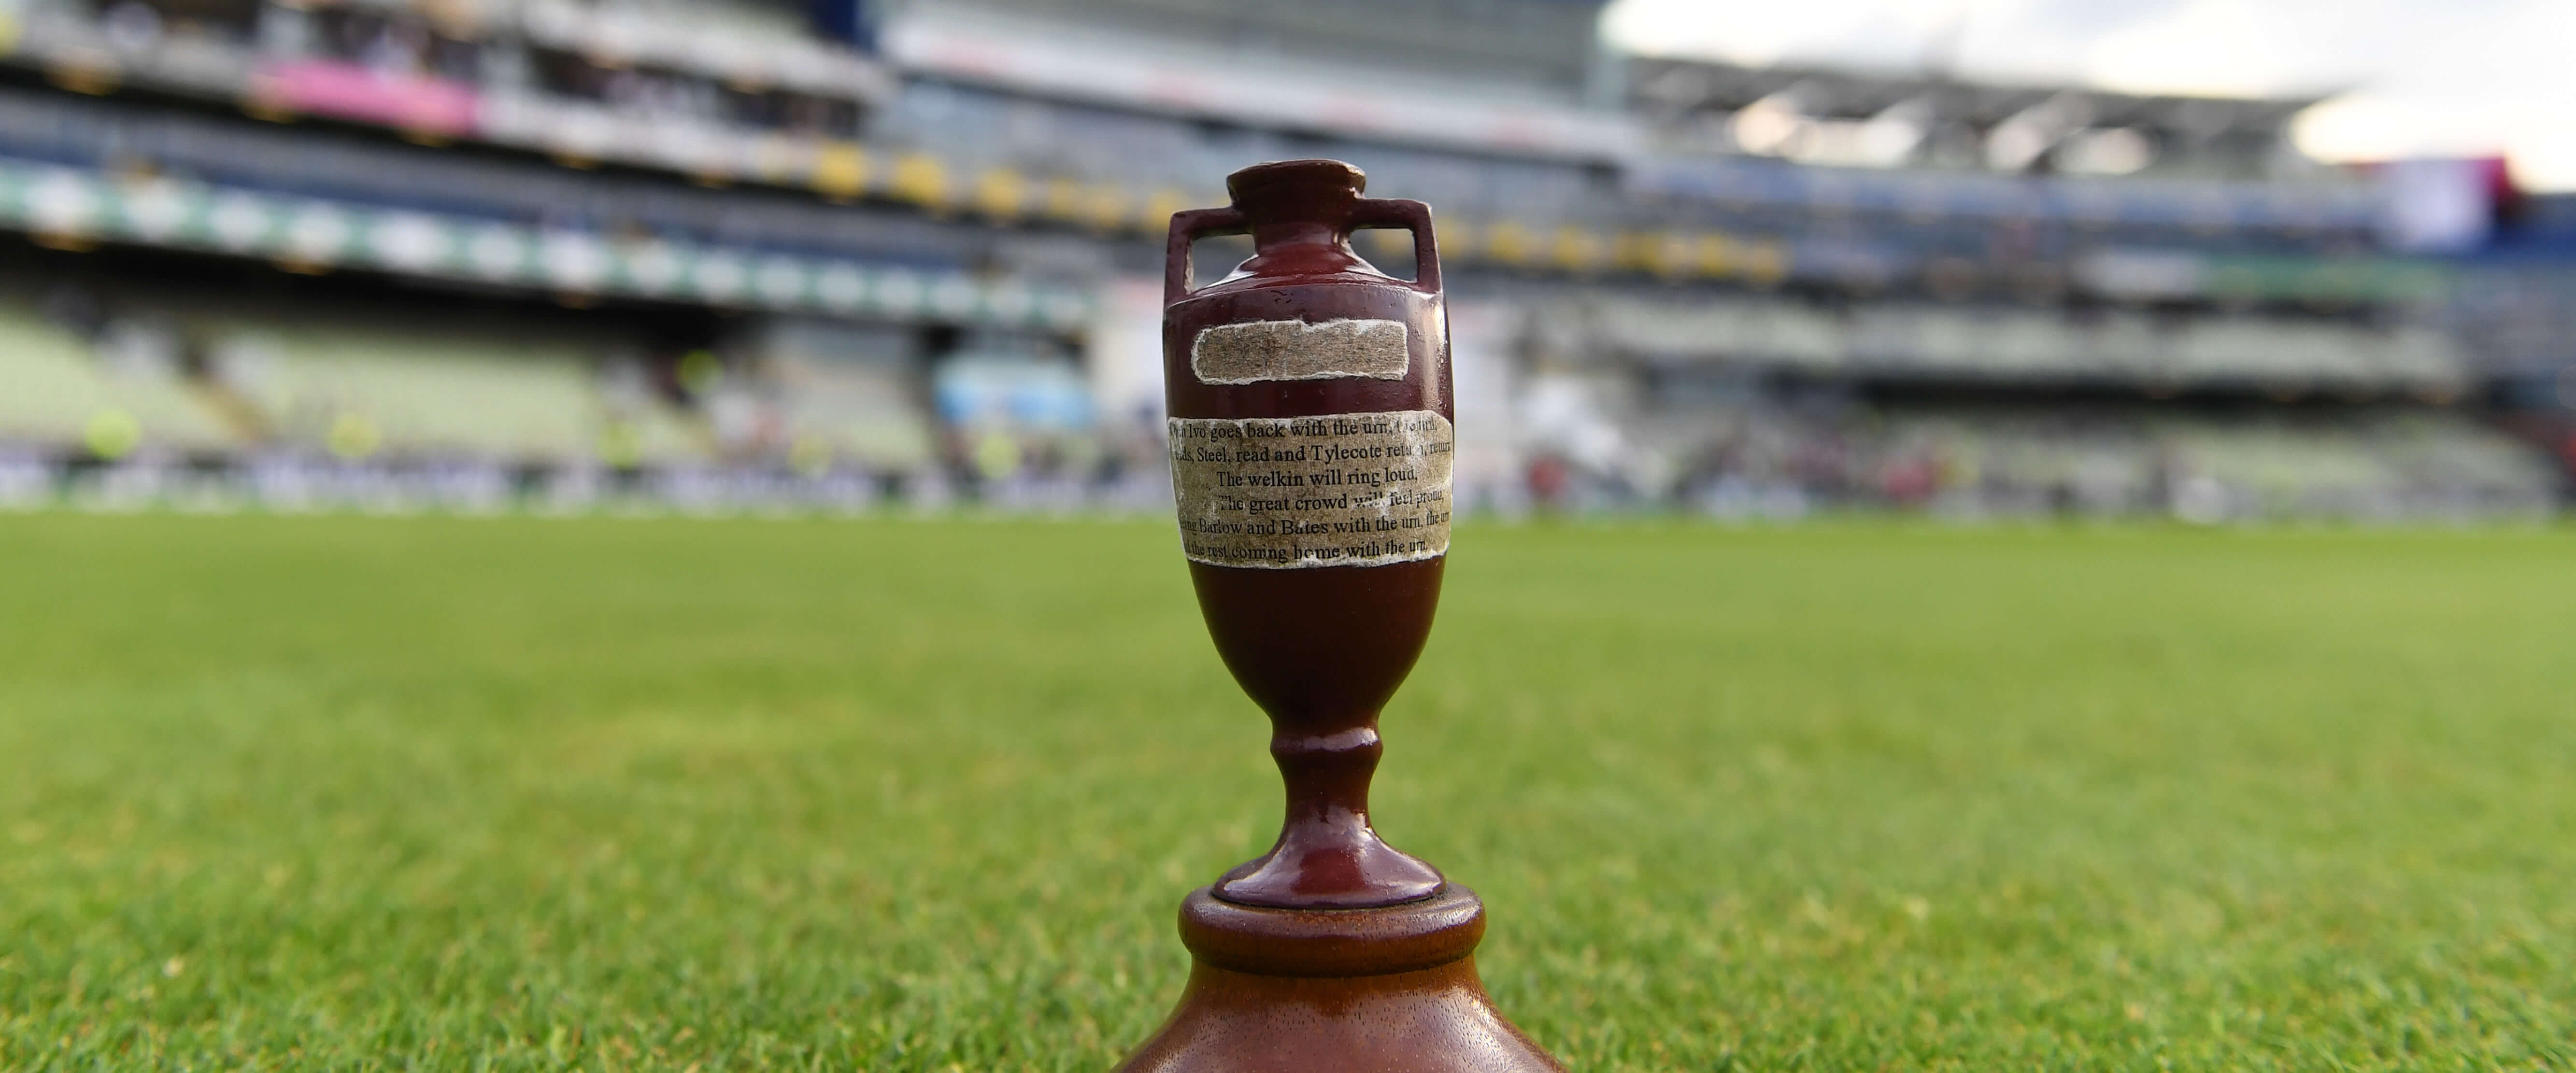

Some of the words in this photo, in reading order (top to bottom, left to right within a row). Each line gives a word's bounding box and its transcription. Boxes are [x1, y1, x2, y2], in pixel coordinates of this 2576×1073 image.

[1189, 424, 1206, 438] Ivo
[1210, 426, 1242, 442] goes
[1246, 423, 1285, 438] back
[1290, 420, 1327, 437] with
[1333, 419, 1358, 435] the
[1363, 423, 1392, 435] urn,
[1197, 446, 1231, 463] Steel,
[1236, 446, 1270, 462] read
[1274, 445, 1306, 461] and
[1310, 444, 1382, 465] Tylecote
[1386, 443, 1427, 458] retun,
[1217, 471, 1243, 487] The
[1248, 470, 1304, 487] welkin
[1309, 468, 1342, 486] will
[1347, 468, 1381, 487] ring
[1384, 466, 1418, 483] loud,
[1219, 495, 1245, 510] The
[1249, 496, 1290, 515] great
[1295, 493, 1347, 510] crowd
[1389, 489, 1413, 507] feel
[1199, 517, 1242, 534] Barlow
[1247, 520, 1277, 535] and
[1281, 518, 1328, 535] Bates
[1333, 517, 1371, 533] with
[1376, 515, 1397, 531] the
[1401, 517, 1423, 529] urn,
[1426, 511, 1439, 526] the
[1192, 540, 1205, 555] the
[1208, 543, 1227, 557] rest
[1232, 544, 1289, 564] coming
[1294, 544, 1341, 559] home
[1346, 541, 1381, 558] with
[1385, 539, 1405, 555] the
